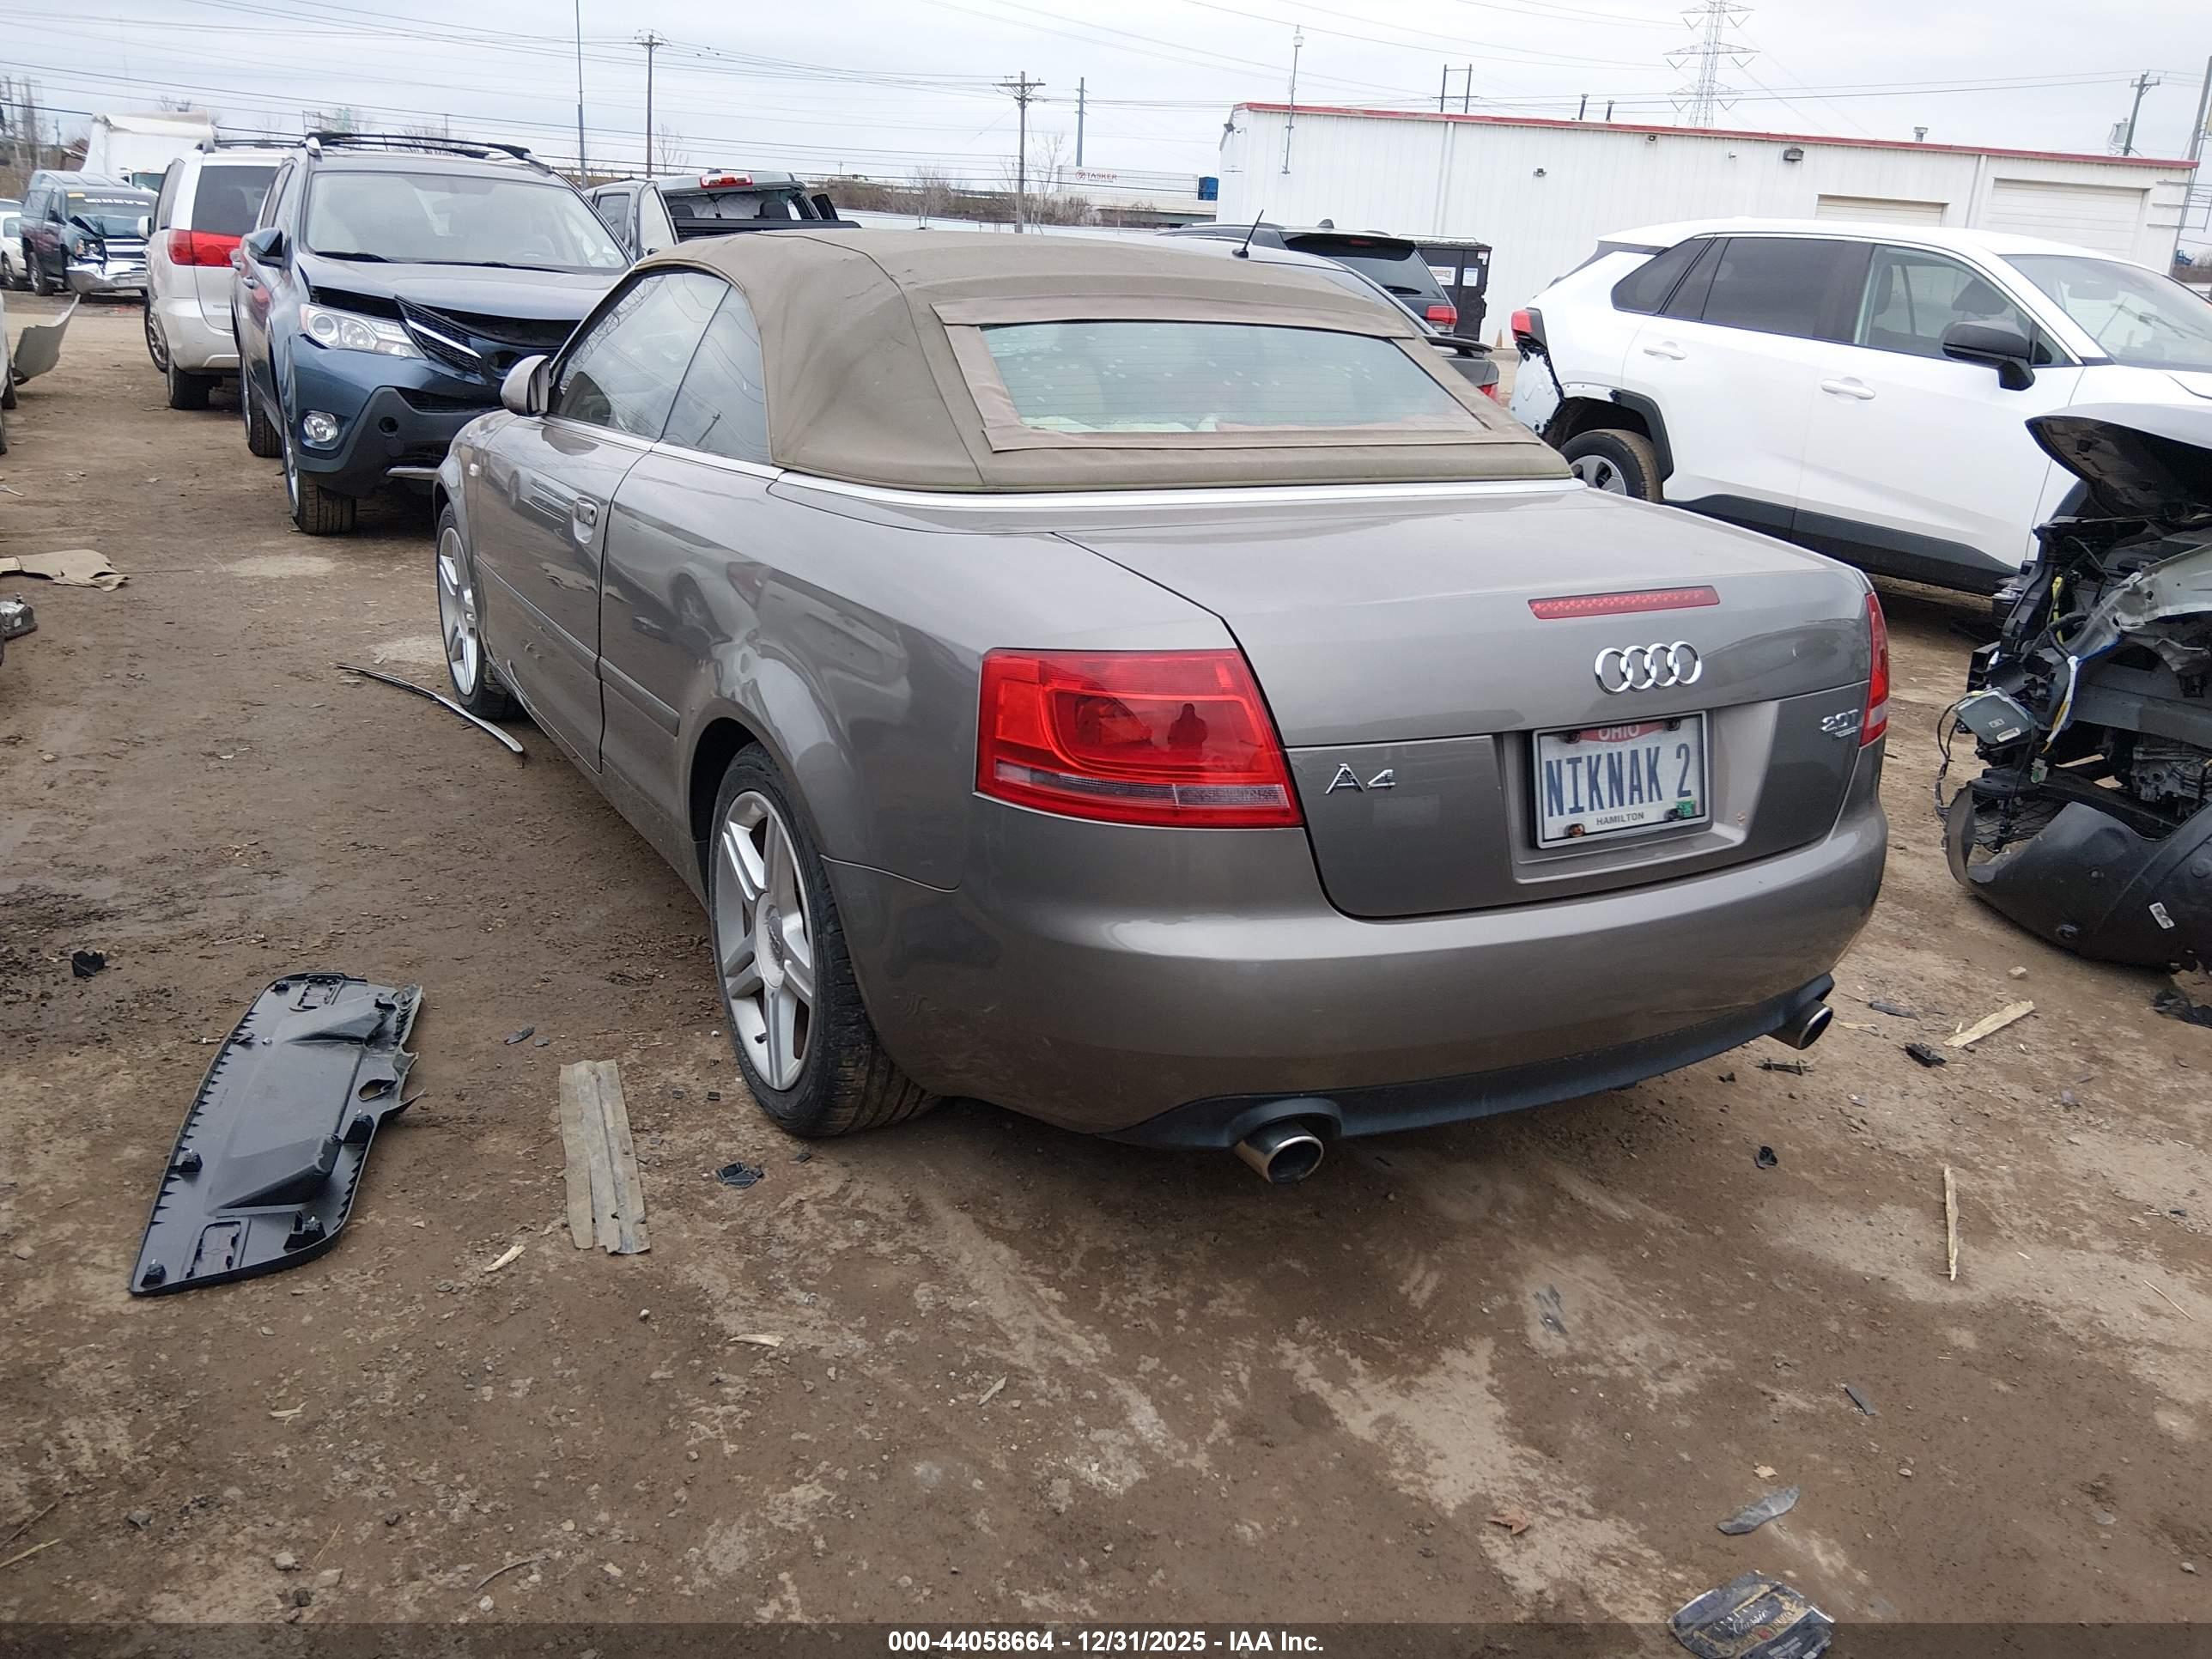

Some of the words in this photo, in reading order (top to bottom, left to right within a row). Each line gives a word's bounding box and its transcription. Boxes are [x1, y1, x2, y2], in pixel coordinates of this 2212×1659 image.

[1598, 724, 1639, 740] OHIO
[1325, 763, 1395, 795] A4
[1546, 746, 1662, 817] NIKNAK
[1676, 744, 1692, 799] 2
[1596, 811, 1644, 826] HAMILTON
